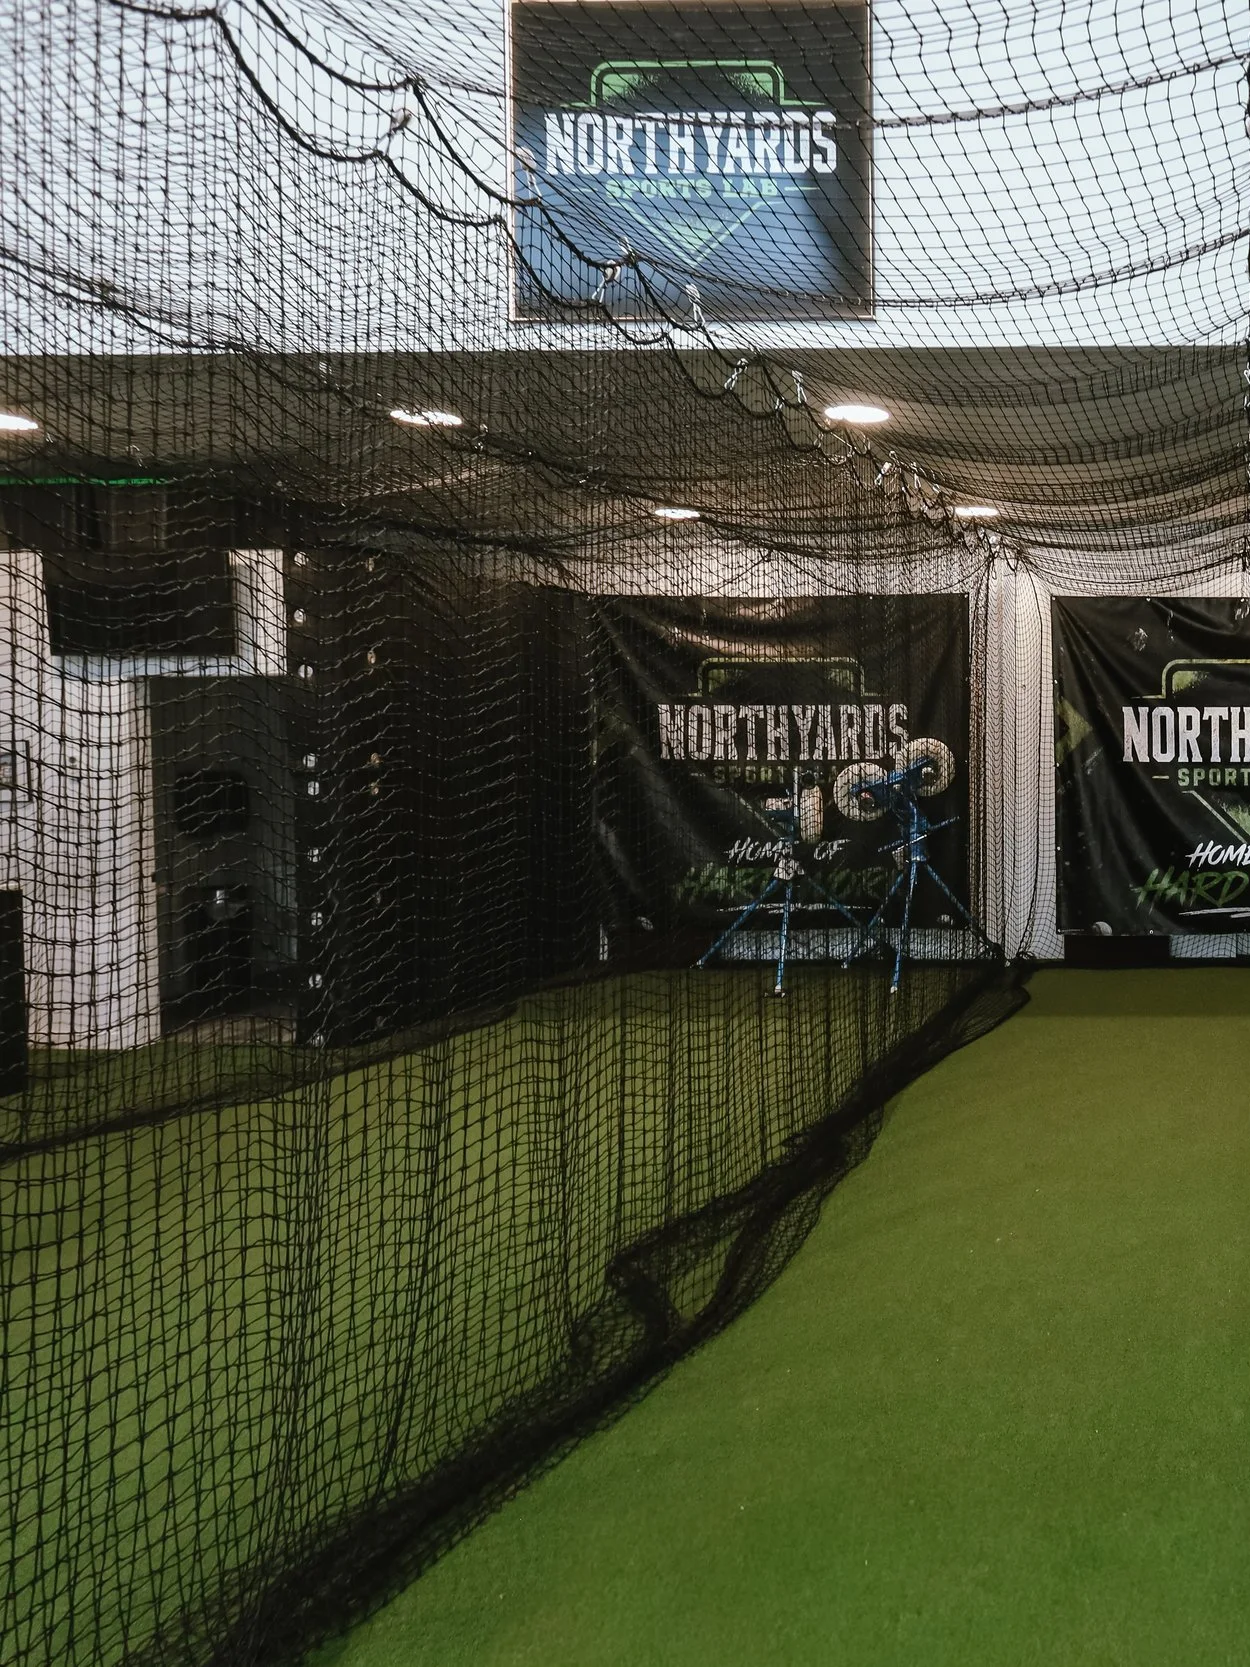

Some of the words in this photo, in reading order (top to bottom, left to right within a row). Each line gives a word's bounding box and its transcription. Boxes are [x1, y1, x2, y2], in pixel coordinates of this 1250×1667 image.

[544, 111, 837, 175] NORTHYARDS
[606, 179, 713, 199] SPORTS
[722, 179, 778, 197] LAB
[657, 703, 909, 761] NORTHYARDS
[812, 838, 853, 861] OF
[1129, 866, 1250, 908] HARD
